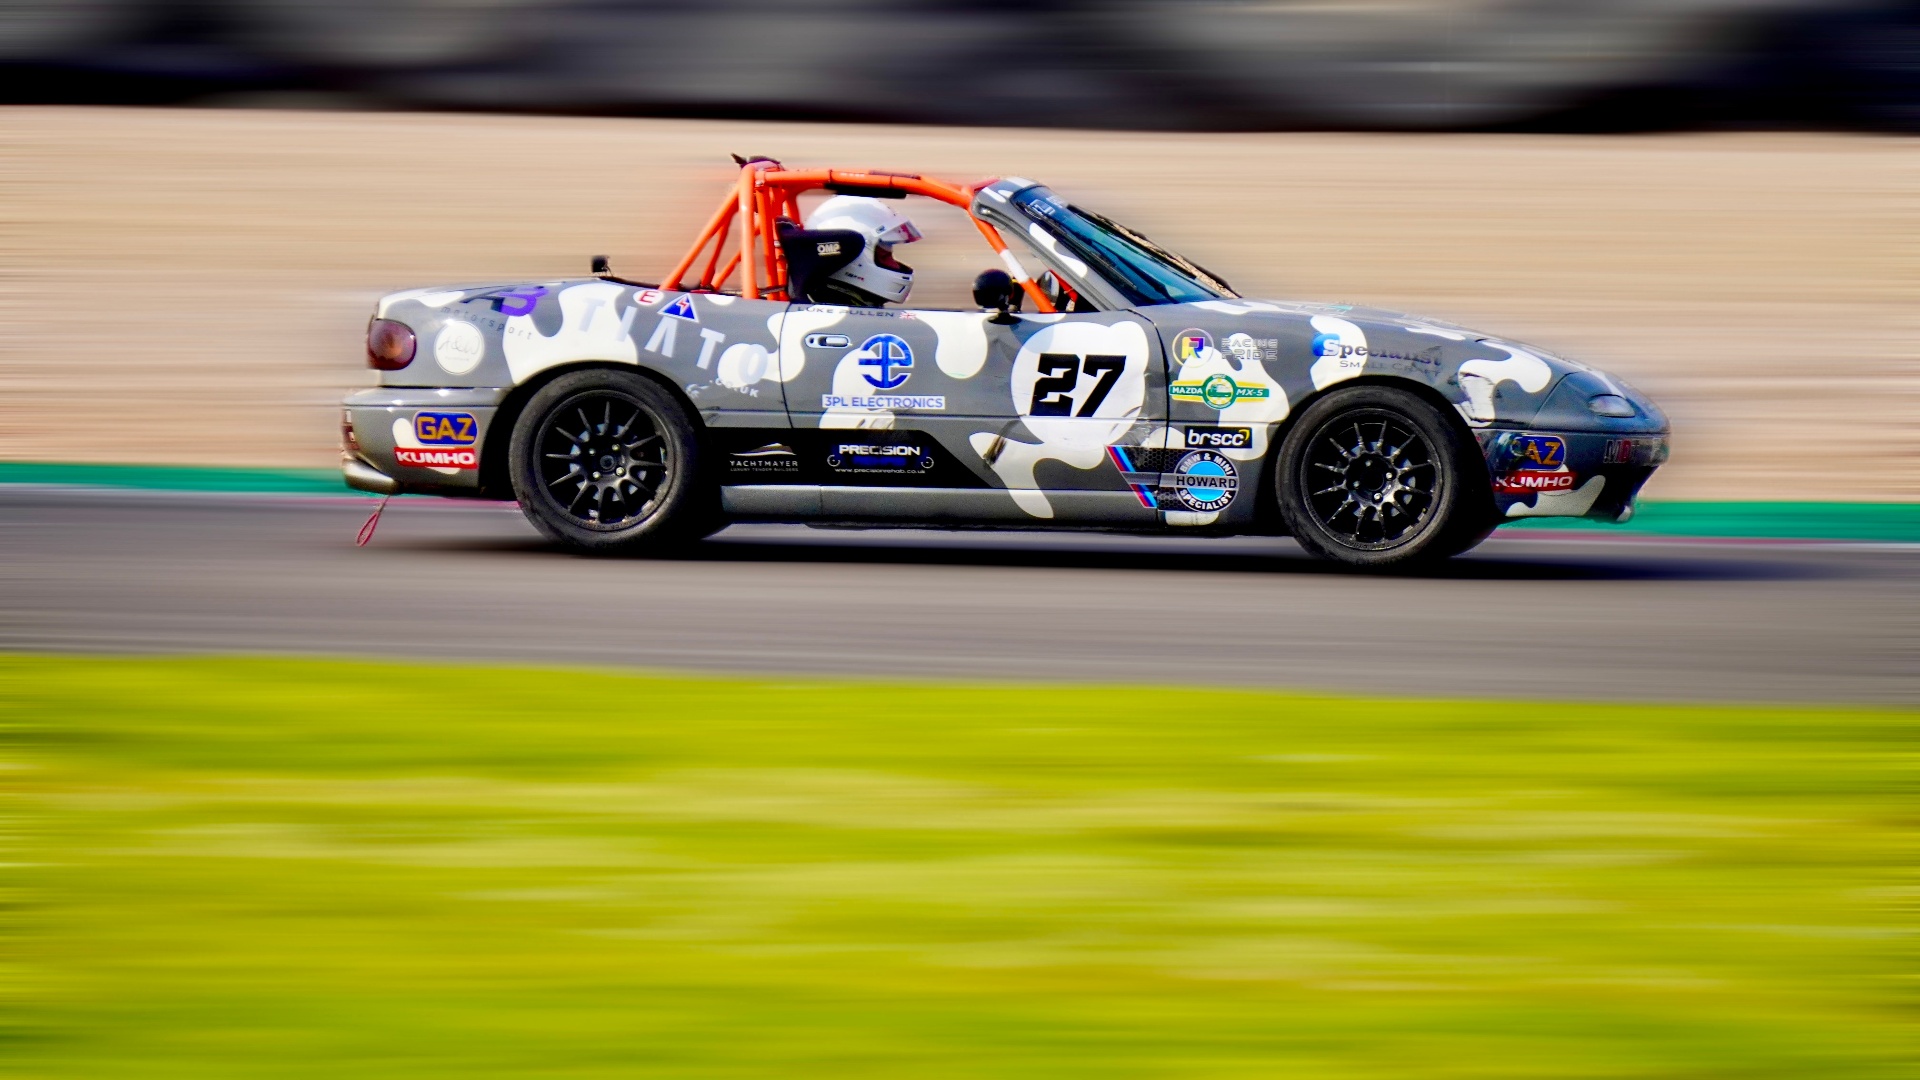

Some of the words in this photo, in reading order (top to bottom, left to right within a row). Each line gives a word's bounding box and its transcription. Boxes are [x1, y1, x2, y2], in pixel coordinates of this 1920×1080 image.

[817, 243, 841, 253] OMP
[638, 290, 657, 304] E
[798, 306, 834, 314] LUKE
[1029, 352, 1127, 418] 27
[1172, 386, 1203, 395] MAZDA
[1236, 388, 1264, 397] MX-5
[825, 396, 849, 407] 3PL
[851, 396, 943, 409] ELECTRONICS
[416, 416, 476, 441] GAZ
[1187, 429, 1244, 446] brscc
[838, 444, 921, 456] PRECISION
[1511, 439, 1561, 466] AZ
[397, 452, 476, 465] KUMHO
[1180, 453, 1200, 473] BMW
[1203, 452, 1212, 461] &
[1213, 455, 1234, 476] MINI
[1176, 475, 1237, 489] HOWARD
[1495, 475, 1573, 488] KUMHO
[1179, 488, 1233, 510] SPECIALIST
